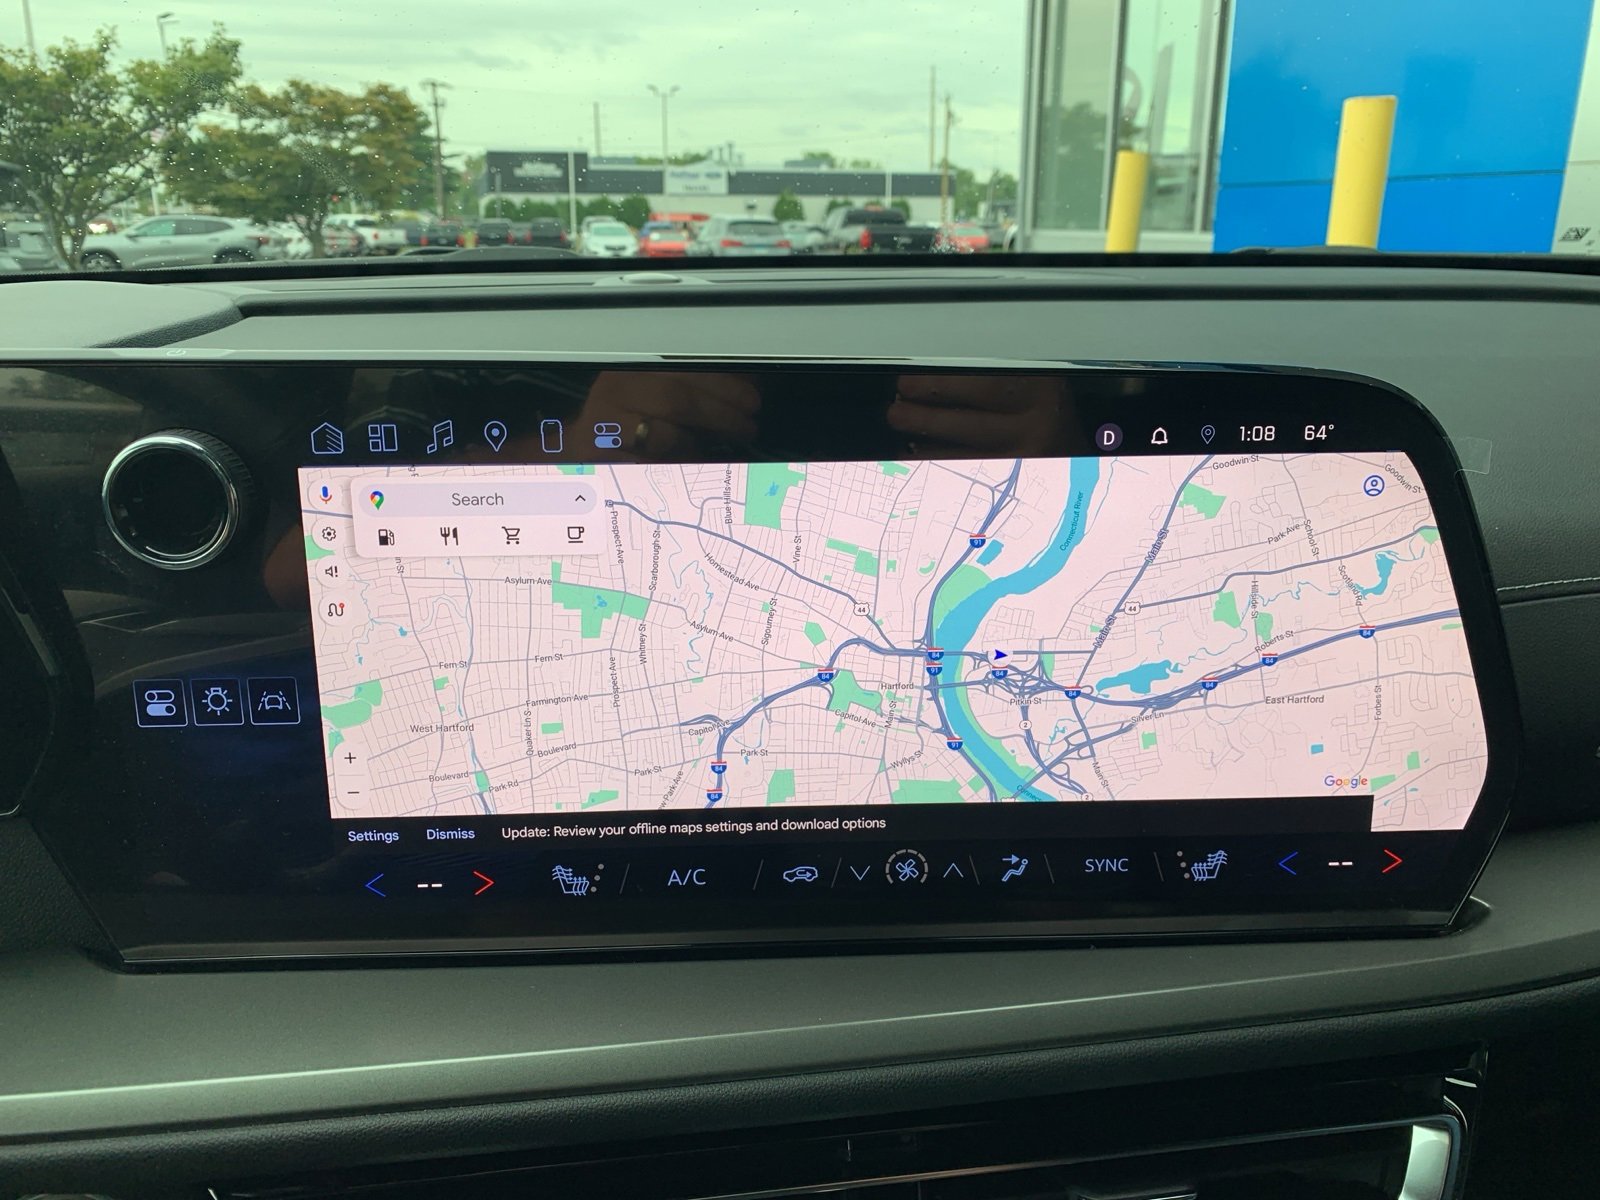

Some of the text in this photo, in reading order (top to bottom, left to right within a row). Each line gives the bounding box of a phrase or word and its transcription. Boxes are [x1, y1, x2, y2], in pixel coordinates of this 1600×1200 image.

[1103, 430, 1115, 445] D
[1239, 425, 1276, 441] 1:08
[1304, 424, 1335, 441] 64°
[1212, 454, 1260, 470] Goodwin St
[1384, 463, 1422, 494] Goodwin St
[451, 492, 505, 507] Search
[723, 469, 733, 525] Blue Hills Ave
[1060, 491, 1084, 551] Connecticut River
[610, 511, 625, 564] Prospect Ave
[1267, 523, 1301, 545] Park Ave
[1304, 519, 1320, 557] School St
[793, 535, 802, 563] Vine St
[1145, 539, 1164, 564] Main
[648, 530, 662, 591] Scarborough St
[504, 576, 553, 586] Asylum Ave
[704, 552, 760, 591] Homestead Ave
[1338, 565, 1363, 606] Scotland Rd
[1251, 580, 1259, 619] Hillside St
[689, 620, 735, 642] Asylum Ave
[761, 597, 778, 646] Sigourney St
[638, 623, 647, 664] Whitney St
[1093, 626, 1112, 648] Main
[1254, 630, 1294, 653] Roberts St
[439, 661, 457, 670] Fern
[534, 653, 563, 663] Fern St
[609, 656, 621, 707] Prospect Ave
[880, 682, 914, 690] Hartford
[526, 696, 572, 707] Farmington
[1010, 697, 1032, 706] Pitkin
[1265, 695, 1325, 704] East Hartford
[1374, 685, 1382, 721] Forbes St
[524, 716, 532, 727] Ln
[835, 708, 877, 729] Capitol Ave
[885, 700, 897, 729] Main St
[1131, 711, 1165, 724] Silver Ln
[410, 723, 474, 733] West Hartford
[688, 718, 731, 736] Capitol Ave
[526, 729, 534, 756] Quaker
[537, 742, 577, 758] Boulevard
[740, 749, 757, 757] Park
[891, 750, 924, 770] Wyllys St
[428, 770, 469, 783] Boulevard
[634, 766, 662, 776] Park St
[1092, 761, 1109, 788] Main St
[488, 779, 519, 793] Park Rd
[663, 785, 677, 801] Park
[672, 770, 684, 784] Ave
[1324, 775, 1368, 788] Google
[348, 829, 399, 844] Settings
[426, 828, 476, 840] Dismiss
[501, 817, 886, 840] Update: Review your offline maps settings and download options
[1084, 858, 1129, 872] SYNC
[667, 868, 707, 886] A/C
